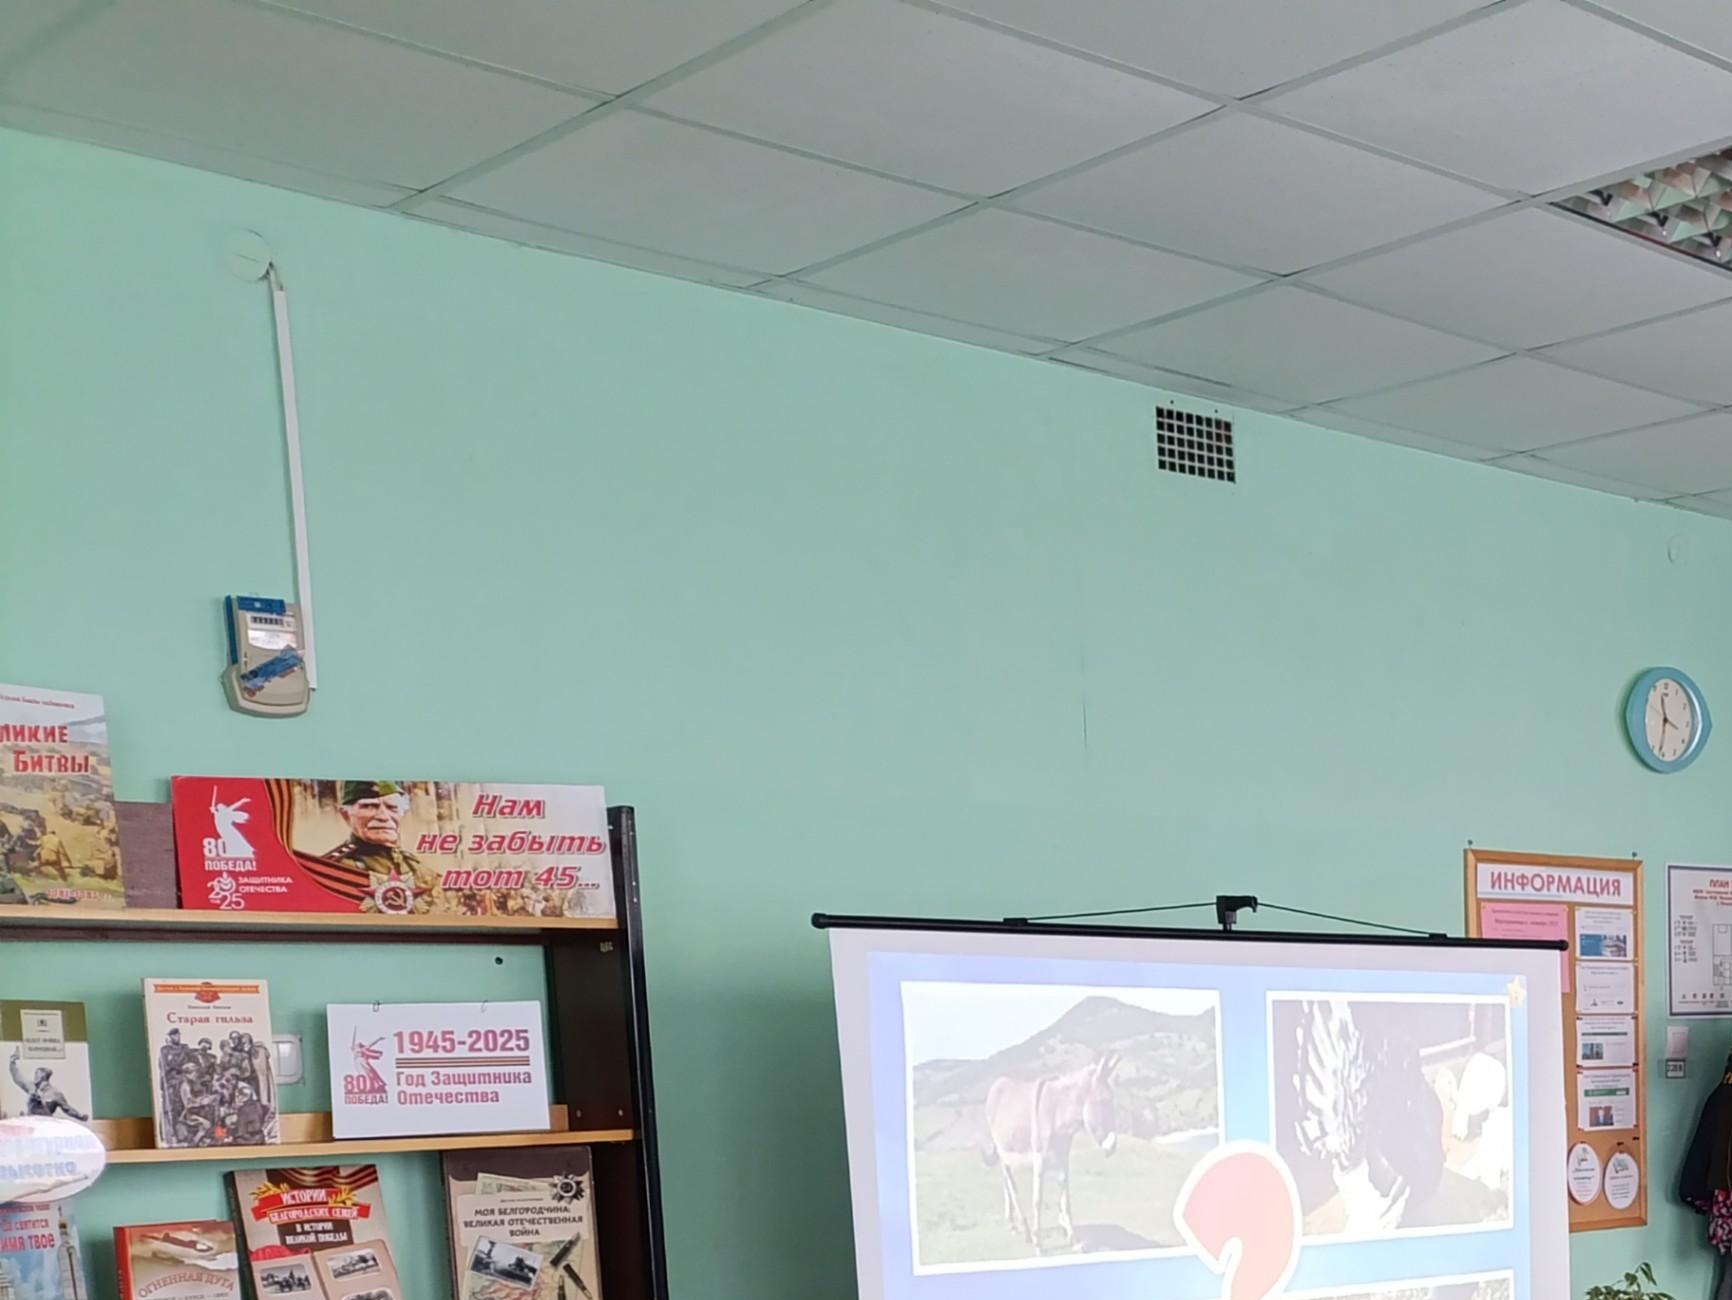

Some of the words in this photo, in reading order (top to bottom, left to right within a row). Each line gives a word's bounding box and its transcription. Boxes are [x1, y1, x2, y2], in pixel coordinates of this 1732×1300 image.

[14, 750, 90, 773] БИТВЫ
[472, 794, 545, 818] Нам
[416, 833, 458, 853] не
[467, 830, 606, 854] забыть
[204, 859, 257, 872] ПОБЕДА!
[238, 876, 293, 884] ЗАЩИТНИКА
[441, 869, 524, 889] тот
[534, 866, 600, 889] 45...
[1490, 871, 1622, 898] ИНФОРМАЦИЯ
[1709, 879, 1730, 889] ПЛАН
[238, 885, 288, 894] ОТЕЧЕСТВА
[167, 1012, 210, 1026] Старая
[215, 1015, 253, 1024] гильза
[393, 1029, 530, 1054] 1945-2025
[343, 1074, 367, 1093] 80
[396, 1072, 426, 1087] Год
[431, 1070, 533, 1086] Защитника
[344, 1093, 389, 1105] ПОБЕДА!
[397, 1089, 500, 1105] Отечества
[280, 1188, 327, 1205] ИСТОРИИ
[474, 1206, 496, 1217] МОЯ
[464, 1218, 505, 1229] ВЕЛИКАЯ
[507, 1215, 583, 1227] ОТЕЧЕСТВЕННАЯ
[509, 1227, 541, 1237] ВОЙНА
[138, 1271, 204, 1298] ОГНЕННАЯ
[204, 1273, 235, 1291] ДУГА
